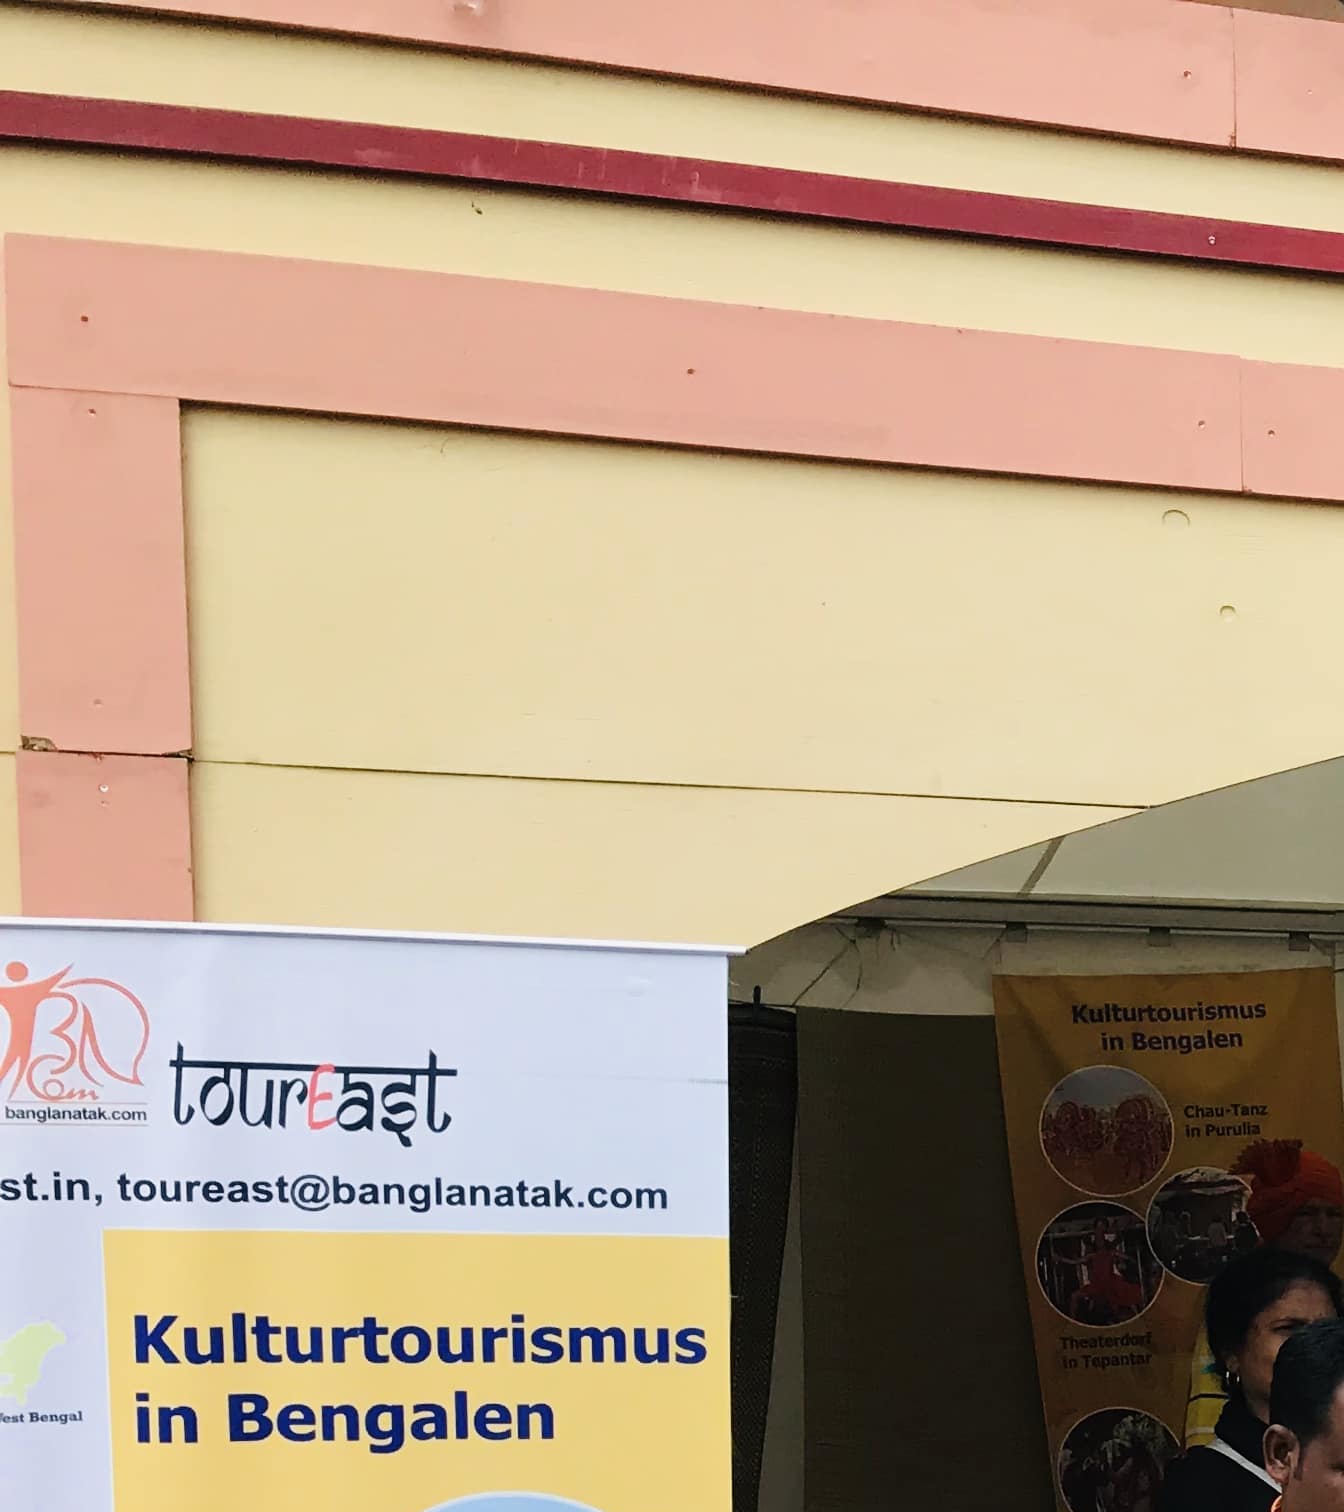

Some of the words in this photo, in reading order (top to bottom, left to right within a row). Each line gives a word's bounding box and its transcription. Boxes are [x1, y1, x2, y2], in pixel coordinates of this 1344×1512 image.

[1072, 1002, 1267, 1024] Kulturtourismus
[1101, 1033, 1123, 1050] in
[1132, 1030, 1243, 1053] Bengalen
[170, 1042, 457, 1147] tourEast
[5, 1105, 148, 1122] banglanatak.com
[1184, 1103, 1268, 1118] Chau-Tanz
[1185, 1124, 1200, 1137] in
[1205, 1122, 1260, 1136] Purulia
[117, 1173, 669, 1212] toureast@banglanatak.com
[133, 1312, 708, 1366] Kulturtourismus
[1059, 1332, 1152, 1349] Theaterdorf
[1063, 1356, 1077, 1368] in
[1081, 1352, 1152, 1369] Tepantar
[29, 1410, 82, 1424] Bengal
[135, 1392, 199, 1444] in
[227, 1390, 556, 1454] Bengalen
